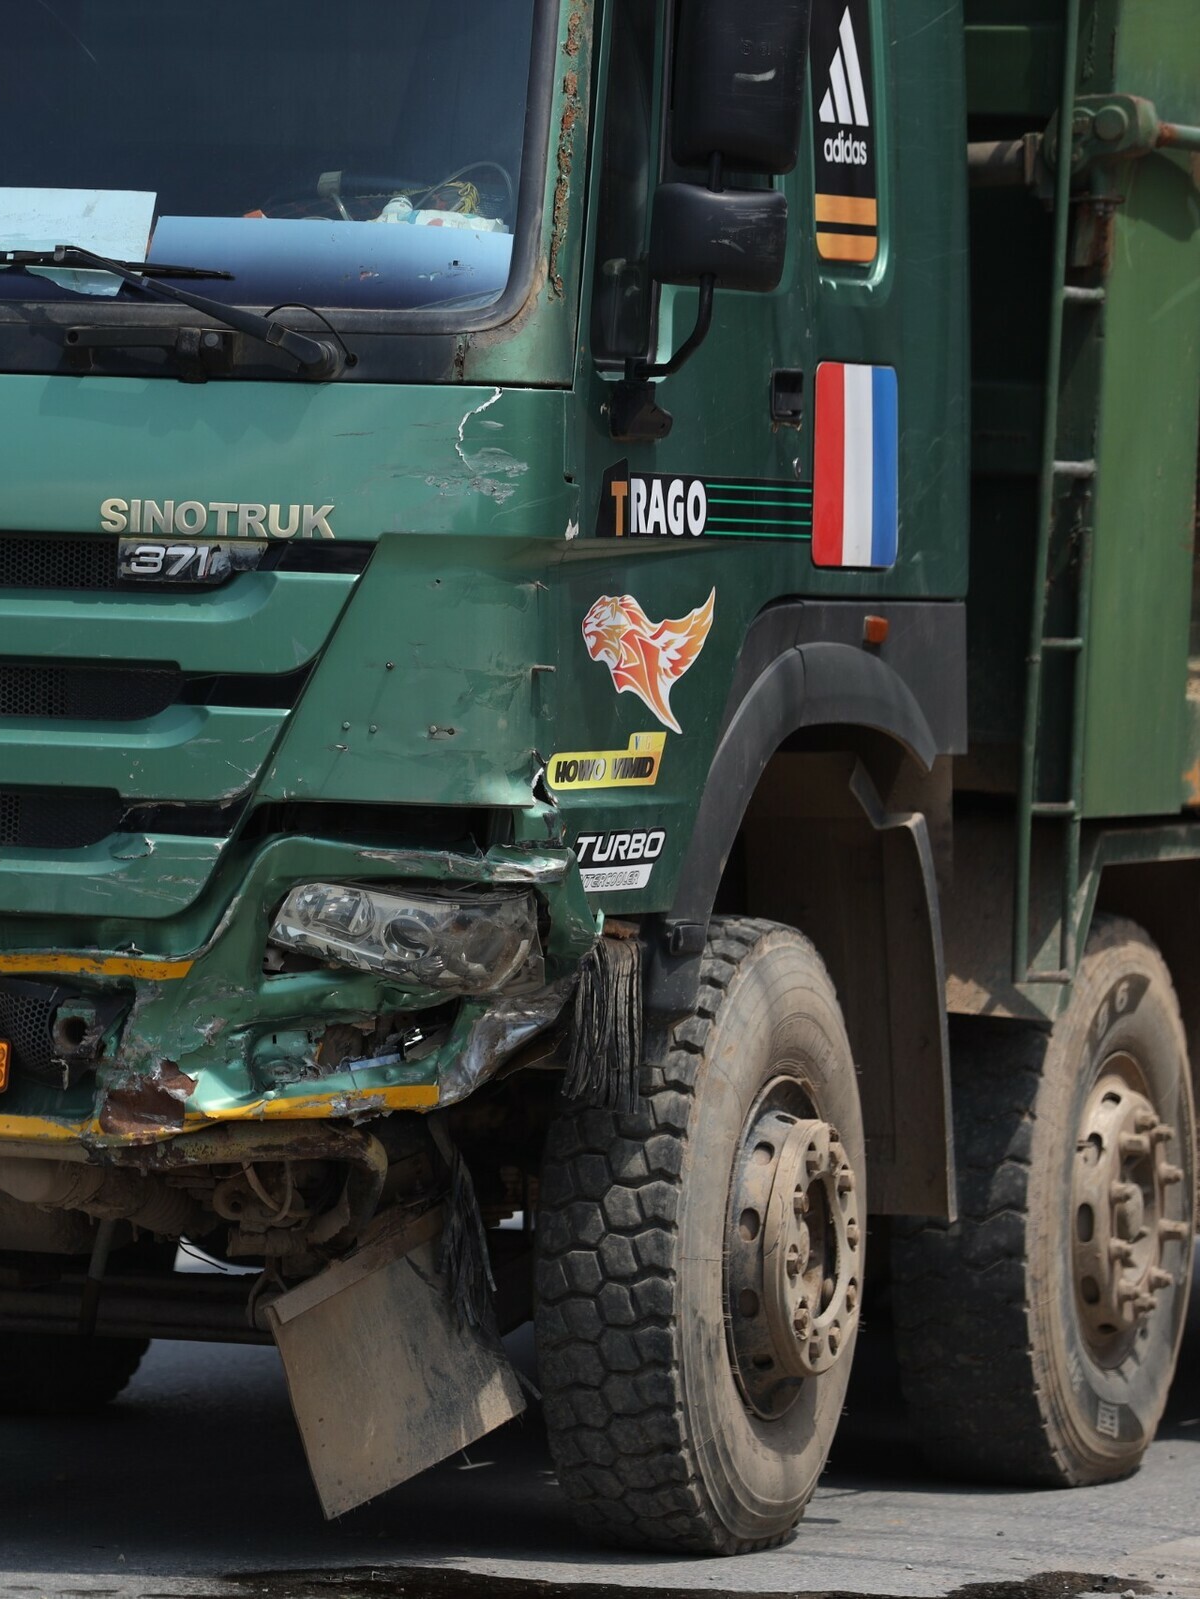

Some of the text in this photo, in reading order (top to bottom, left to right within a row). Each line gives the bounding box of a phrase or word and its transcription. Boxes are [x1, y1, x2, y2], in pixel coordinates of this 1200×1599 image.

[824, 130, 867, 165] adidas
[101, 498, 335, 539] SINOTRUK
[611, 479, 707, 536] TRAGO
[555, 758, 606, 783] HOWO
[577, 831, 666, 862] TURBO
